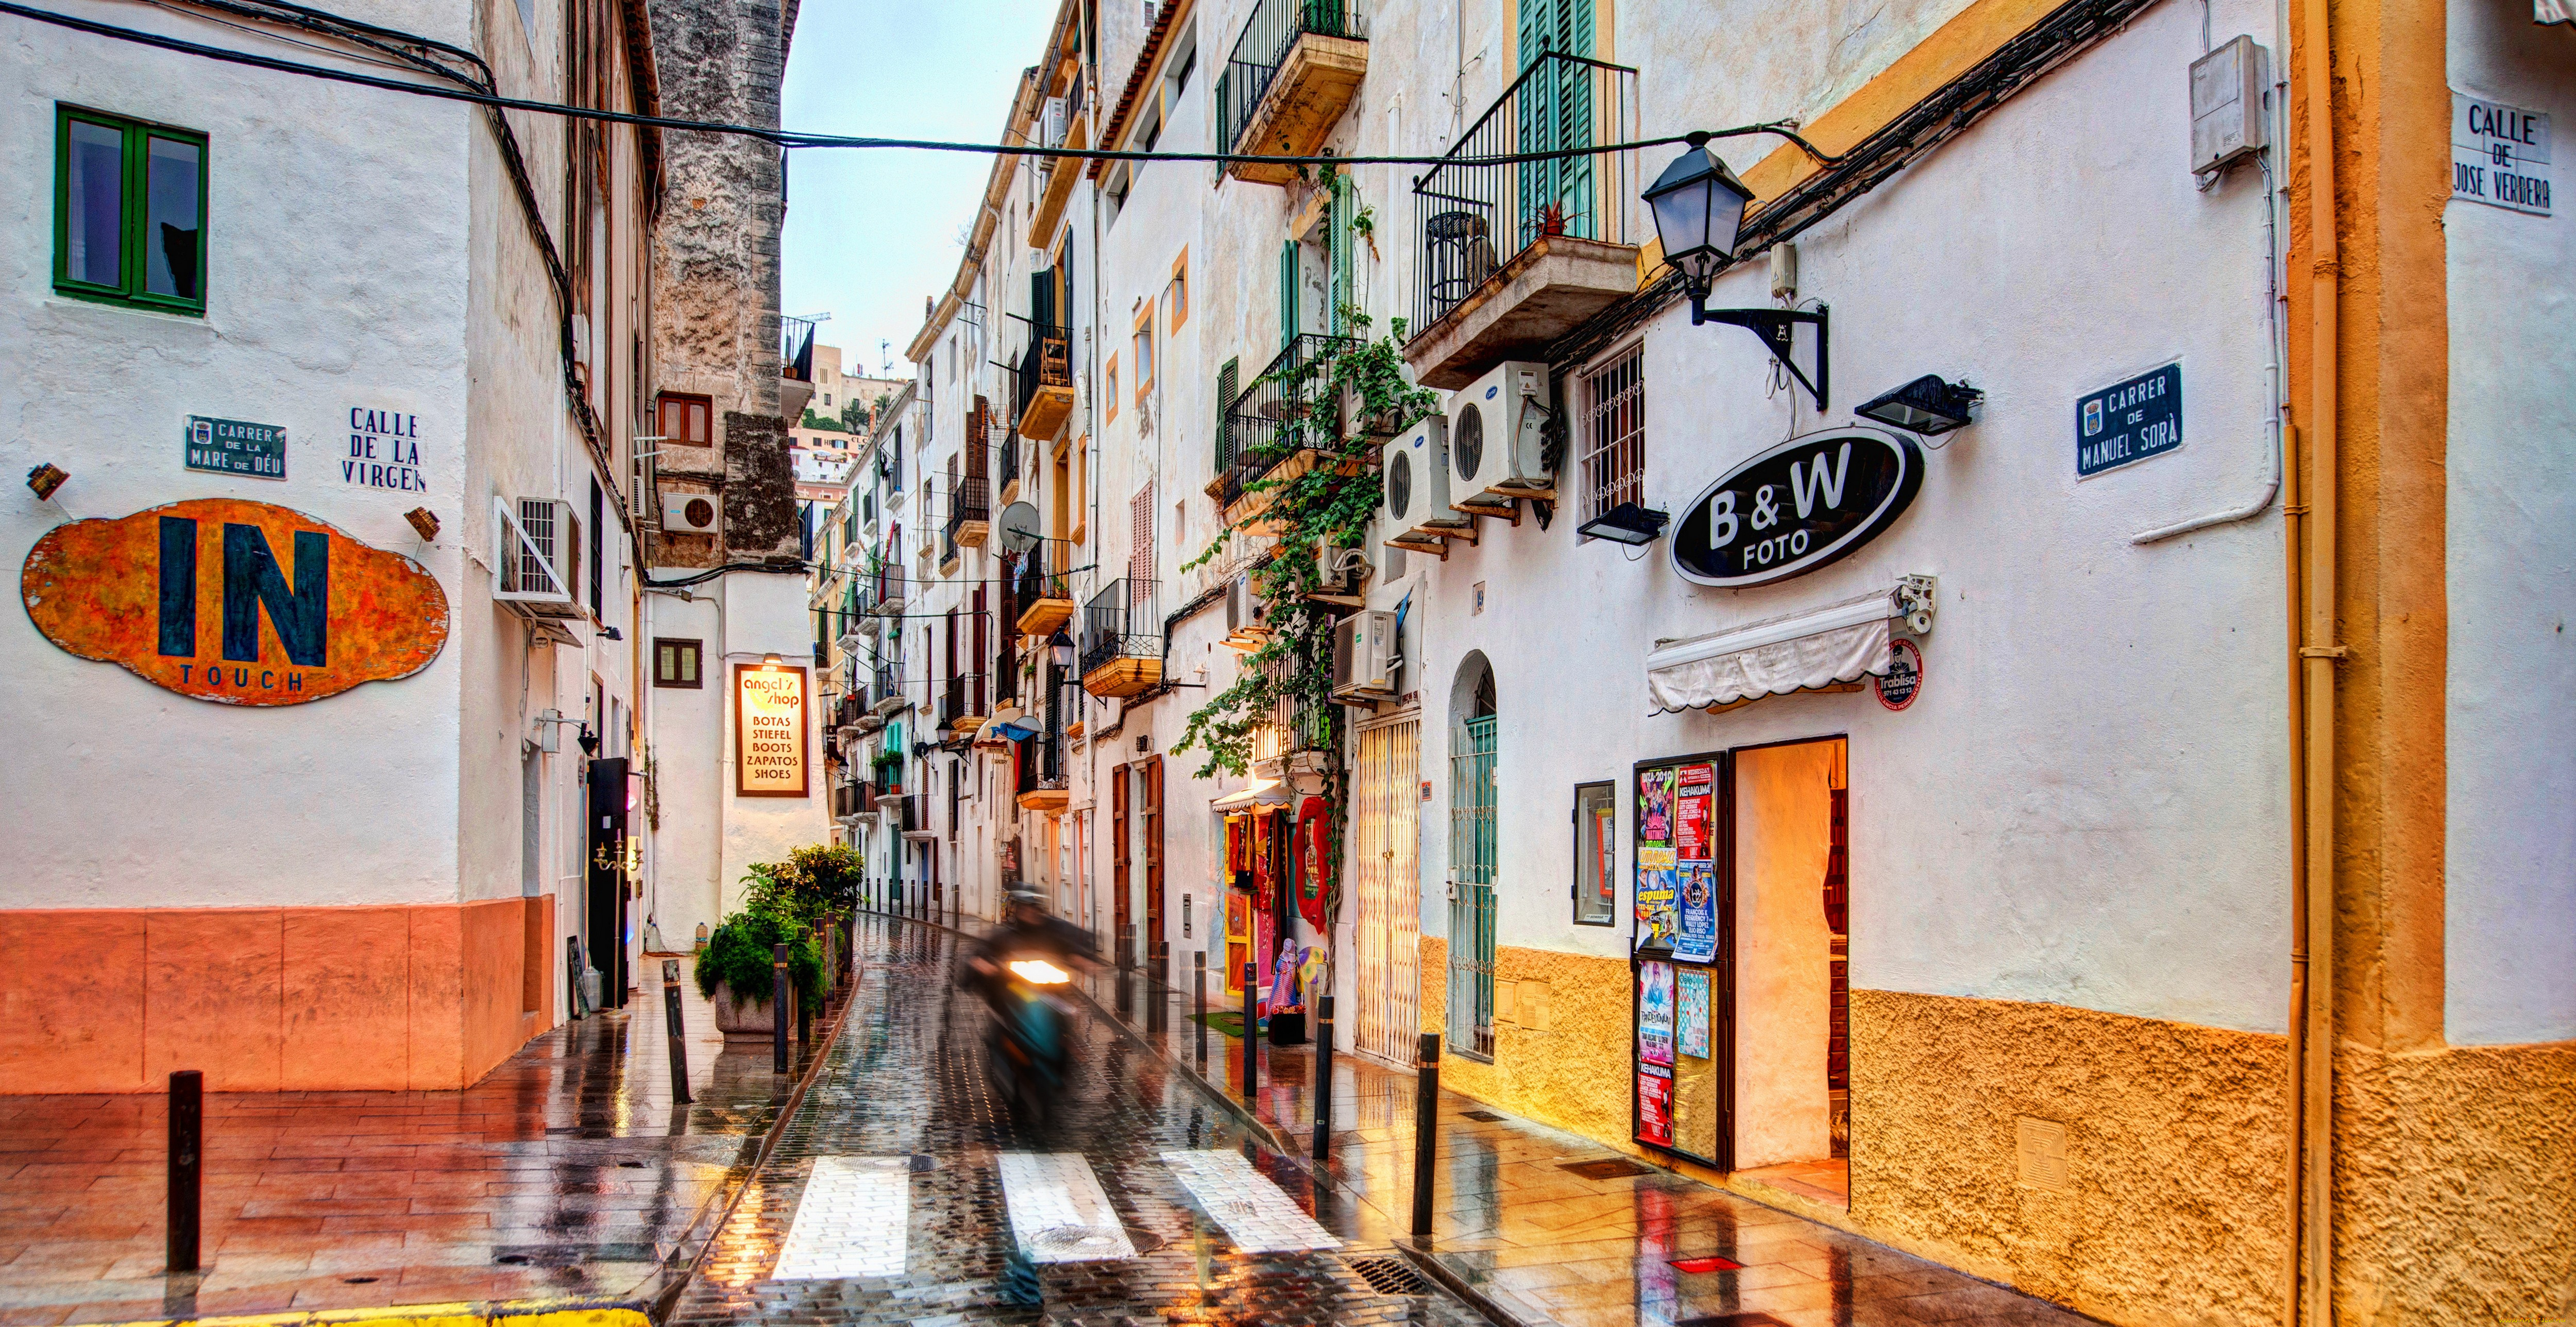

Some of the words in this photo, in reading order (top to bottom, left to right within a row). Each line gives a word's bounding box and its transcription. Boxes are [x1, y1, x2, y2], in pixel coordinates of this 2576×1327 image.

[2469, 105, 2536, 145] CALLE
[2493, 143, 2512, 167] DE
[2454, 163, 2484, 196] JOSE
[2494, 172, 2550, 208] VERDERA
[2109, 376, 2165, 412] CARRER
[350, 407, 419, 437] CALLE
[2128, 410, 2143, 425] DE
[218, 424, 272, 441] CARRER
[2083, 433, 2131, 470] MANUEL
[2141, 413, 2178, 451] SORÀ
[225, 441, 241, 449] DE
[246, 444, 261, 452] LA
[350, 434, 377, 458] DE
[394, 440, 419, 465] LA
[191, 449, 228, 467] MARE
[234, 461, 248, 470] DE
[255, 455, 280, 473] DÉU
[343, 461, 426, 492] VIRGEN
[1743, 530, 1808, 570] FOTO
[158, 516, 329, 667] IN
[1478, 590, 1483, 607] 19
[1903, 640, 1920, 661] ALARMA
[179, 665, 301, 691] TOUCH
[1879, 674, 1916, 689] Trablisa
[768, 692, 799, 708] shop
[1876, 685, 1897, 709] VIGILANCIA
[1898, 672, 1922, 709] PERMANENTE
[753, 717, 790, 726] BOTAS
[753, 730, 791, 739] STIEFEL
[753, 743, 792, 753] BOOTS
[747, 756, 798, 765] ZAPATOS
[755, 770, 791, 778] SHOES
[1680, 785, 1710, 797] KEHAKUMA
[1638, 890, 1674, 904] espuma
[1641, 1062, 1671, 1079] KEHAKUMA
